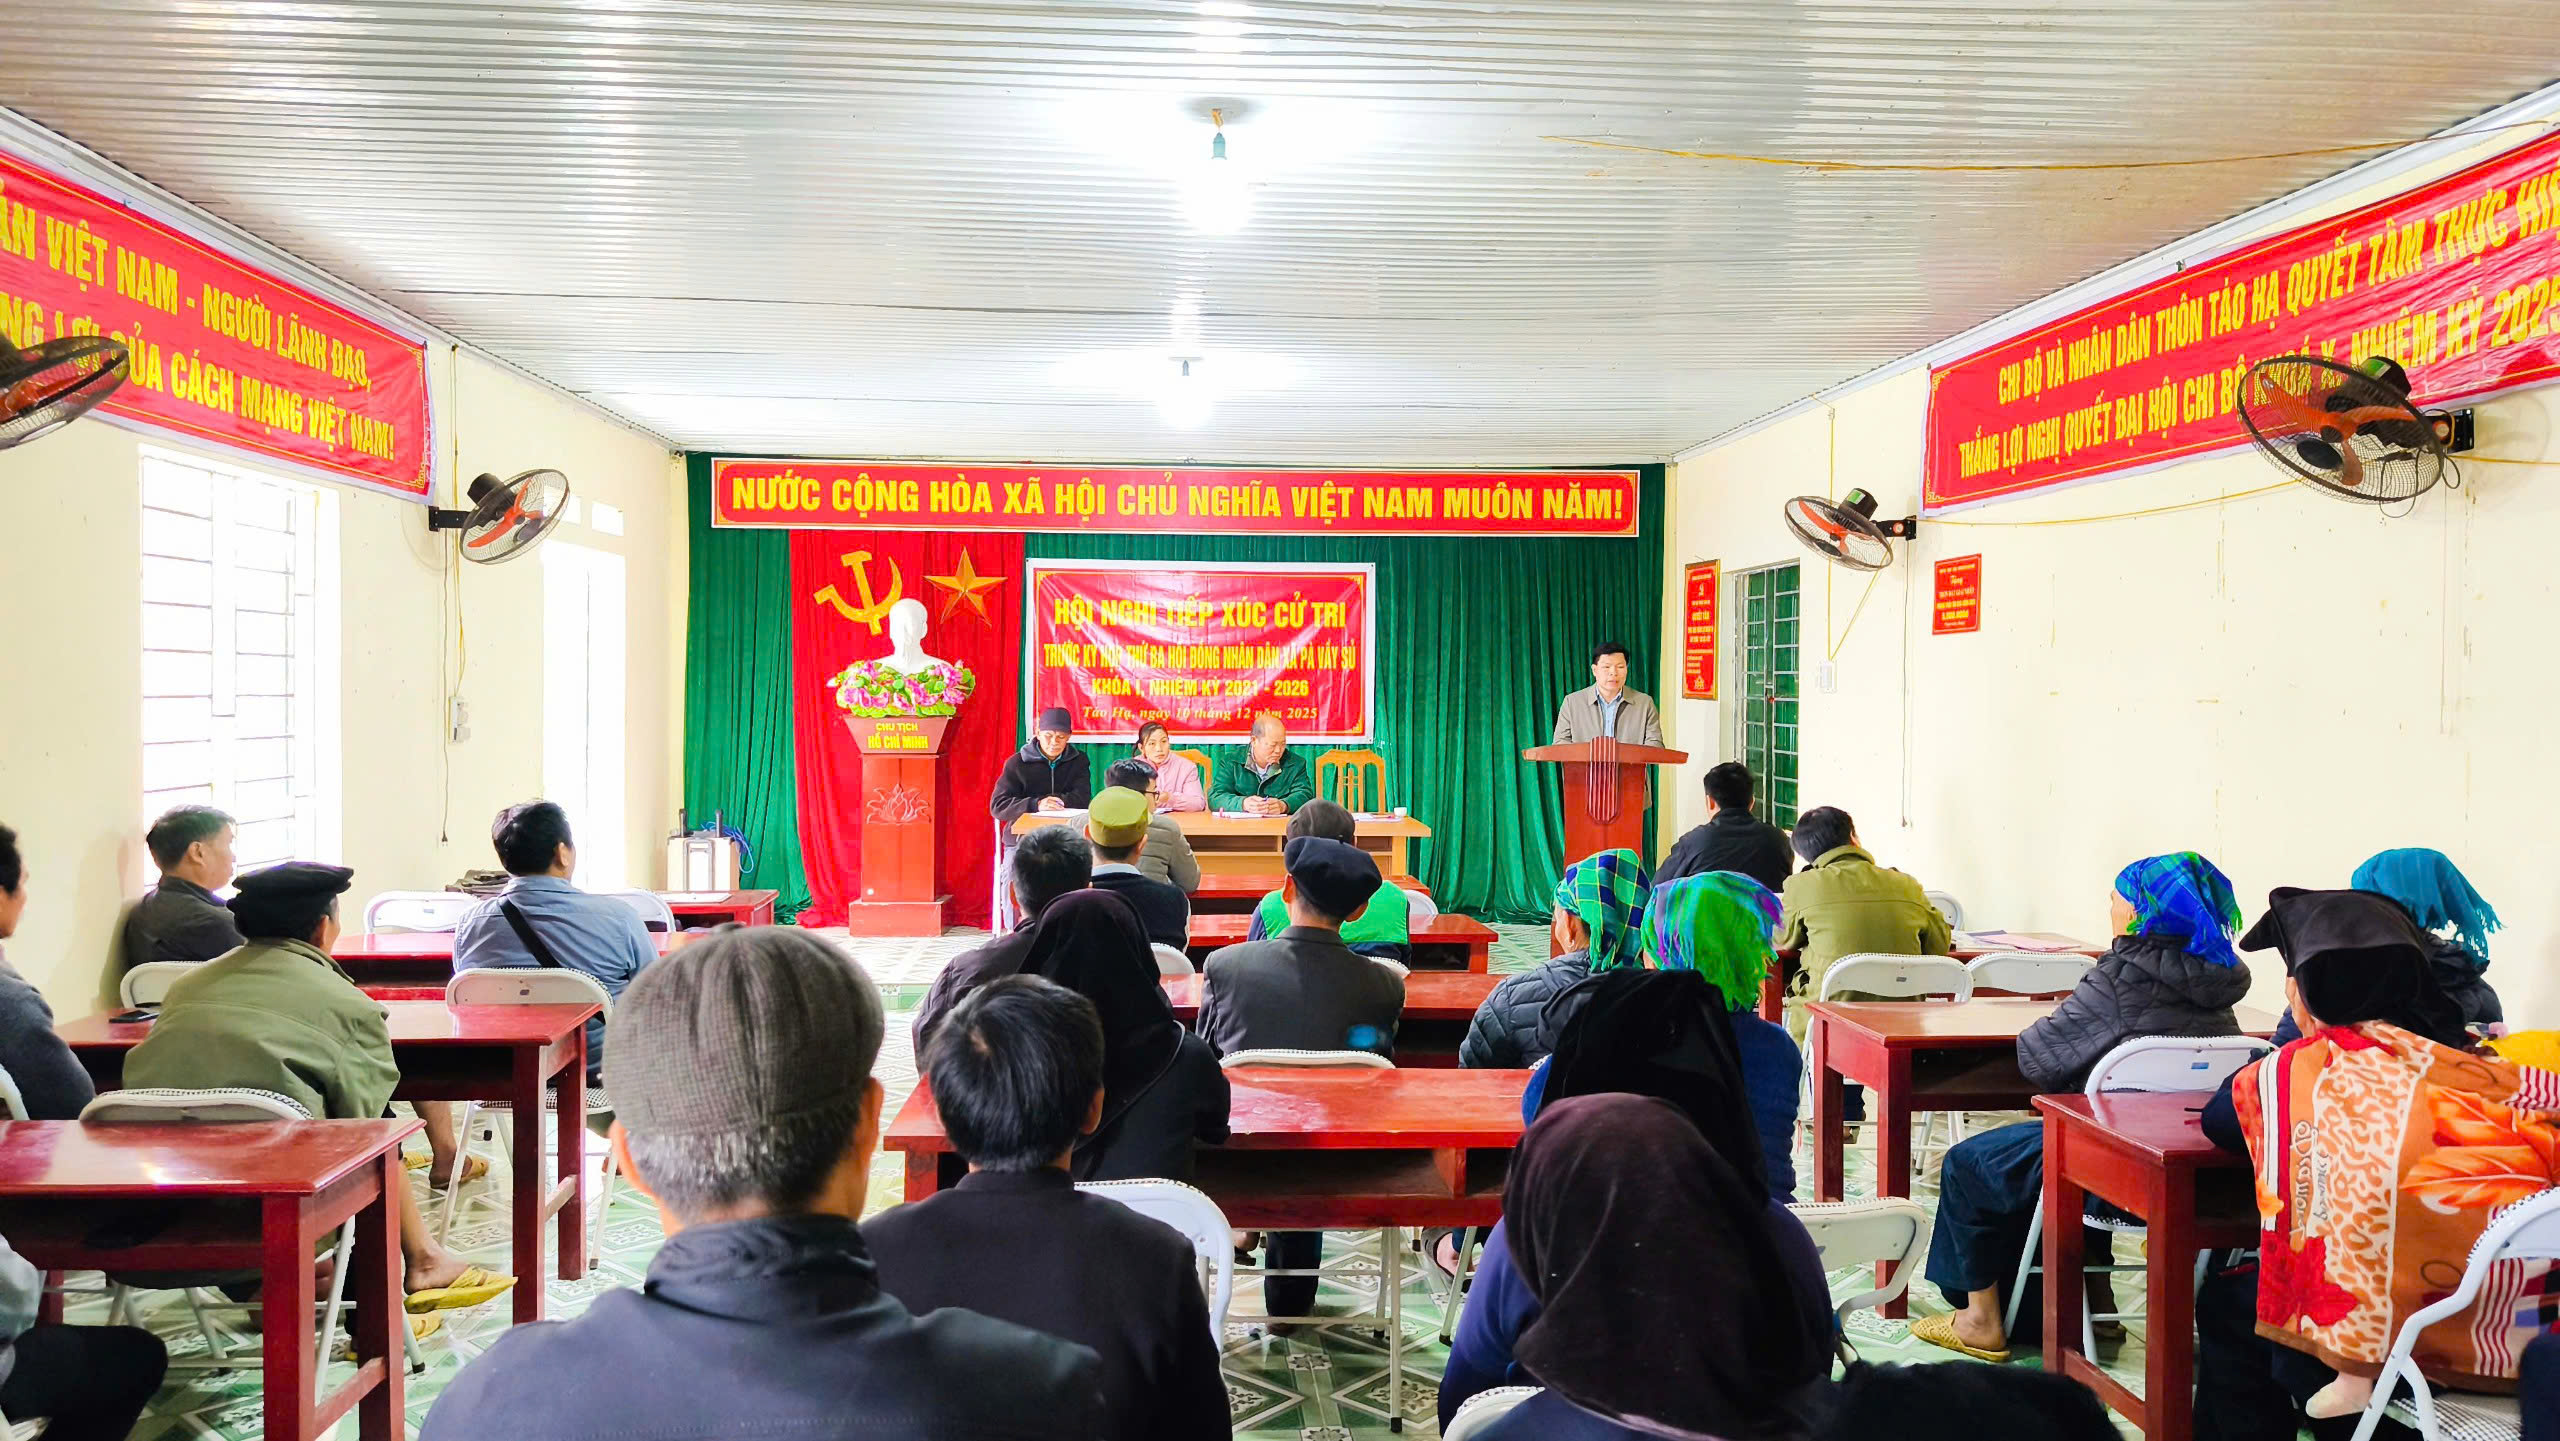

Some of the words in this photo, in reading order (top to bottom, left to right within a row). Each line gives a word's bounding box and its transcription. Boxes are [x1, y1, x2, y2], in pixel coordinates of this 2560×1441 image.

[46, 219, 107, 292] VIỆT
[117, 245, 179, 316] NAM
[203, 283, 271, 352] NGƯỜI
[277, 306, 327, 372] LÃNH
[331, 343, 372, 392] ĐẠO,
[1999, 365, 2020, 404] CHI
[2024, 347, 2042, 401] BỘ
[2046, 339, 2064, 389] VÀ
[2069, 326, 2112, 382] NHÂN
[2115, 310, 2151, 367] DÂN
[2156, 294, 2202, 350] THÔN
[2251, 270, 2280, 330] HẠ
[2286, 229, 2363, 316] QUYẾT
[2368, 218, 2426, 286] TÂM
[2434, 188, 2508, 266] THỰC
[171, 348, 233, 414] CÁCH
[241, 376, 303, 435] MẠNG
[308, 397, 345, 452] VIỆT
[351, 414, 395, 460] NAM!
[1959, 425, 1999, 478] THẮNG
[2003, 423, 2024, 475] LỢI
[2027, 416, 2060, 464] NGHỊ
[2064, 390, 2112, 455] QUYẾT
[2115, 396, 2143, 446] ĐẠI
[2148, 378, 2177, 438] HỘI
[2184, 368, 2214, 423] CHI
[732, 469, 820, 511] NƯỚC
[832, 473, 919, 518] CỘNG
[930, 474, 992, 513] HÒA
[1003, 476, 1044, 515] XÃ
[1055, 477, 1105, 521] HỘI
[1117, 472, 1176, 515] CHỦ
[1188, 480, 1281, 517] NGHĨA
[1291, 481, 1353, 524] VIỆT
[1364, 487, 1432, 519] NAM
[1443, 482, 1532, 519] MUÔN
[1543, 482, 1622, 520] NĂM!
[1054, 594, 1093, 630] HỘI
[1166, 592, 1213, 627] TIẾP
[1221, 596, 1267, 628] XÚC
[1273, 591, 1308, 628] CỬ
[1311, 602, 1345, 627] TRI
[1151, 646, 1164, 668] BA
[1168, 641, 1186, 673] HỘI
[1224, 641, 1253, 669] NHÂN
[1257, 641, 1280, 669] DÂN
[1092, 675, 1131, 695] KHÓA
[1150, 676, 1198, 699] NHIỆM
[1224, 680, 1258, 696] 2021
[1274, 680, 1309, 696] 2026
[1194, 707, 1231, 721] tháng
[1237, 707, 1251, 719] 12
[1287, 707, 1318, 719] 2025
